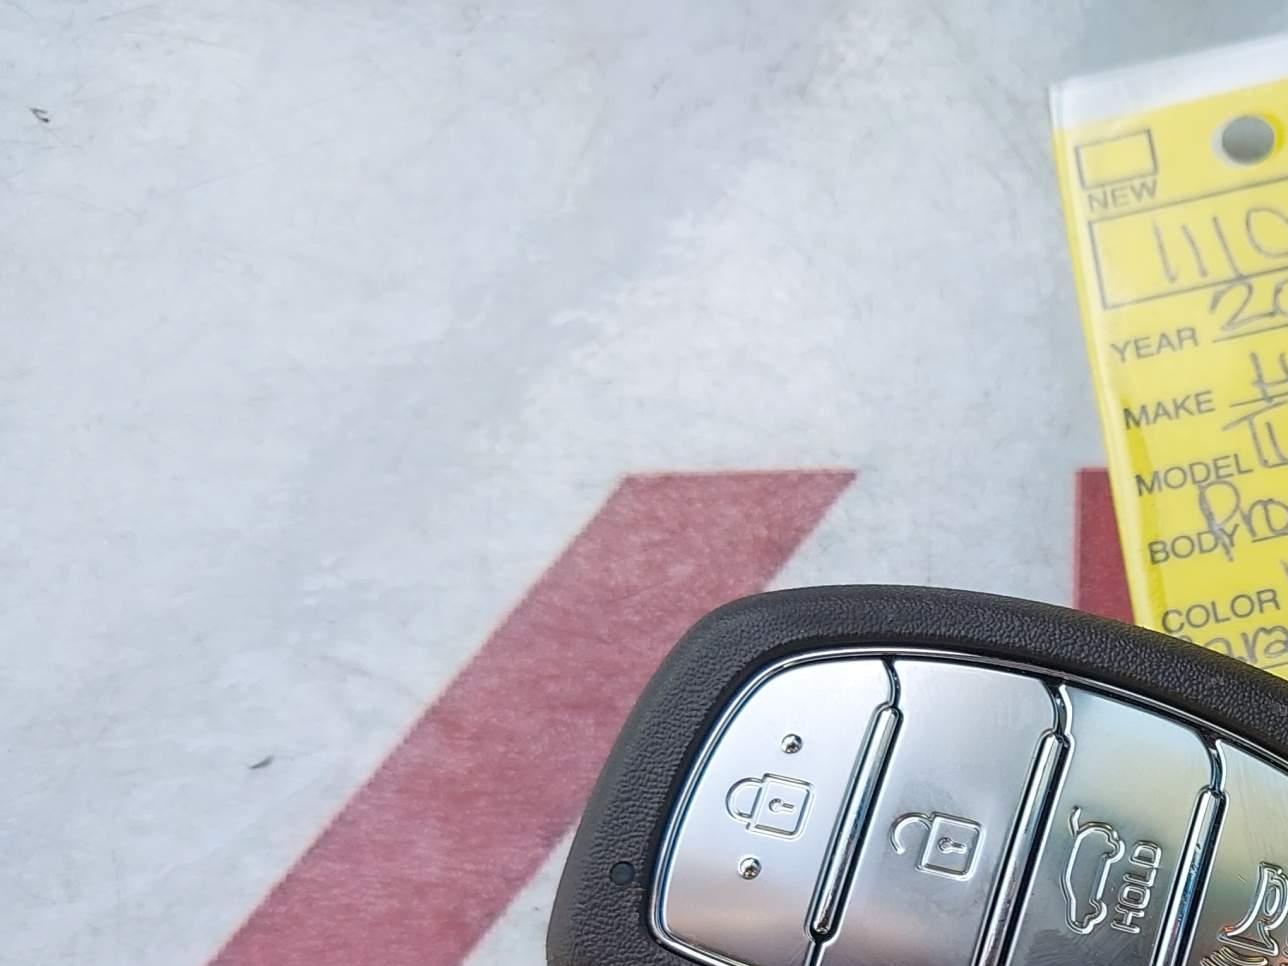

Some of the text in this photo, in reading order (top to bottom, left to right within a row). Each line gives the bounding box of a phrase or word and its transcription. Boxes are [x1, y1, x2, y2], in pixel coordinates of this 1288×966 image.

[1087, 179, 1159, 213] NEW
[1111, 326, 1199, 363] YEAR
[1124, 391, 1215, 429] MAKE
[1136, 453, 1254, 496] MODEL
[1149, 524, 1241, 566] BODY
[1161, 590, 1280, 633] COLOR
[1111, 840, 1161, 934] HOLD
